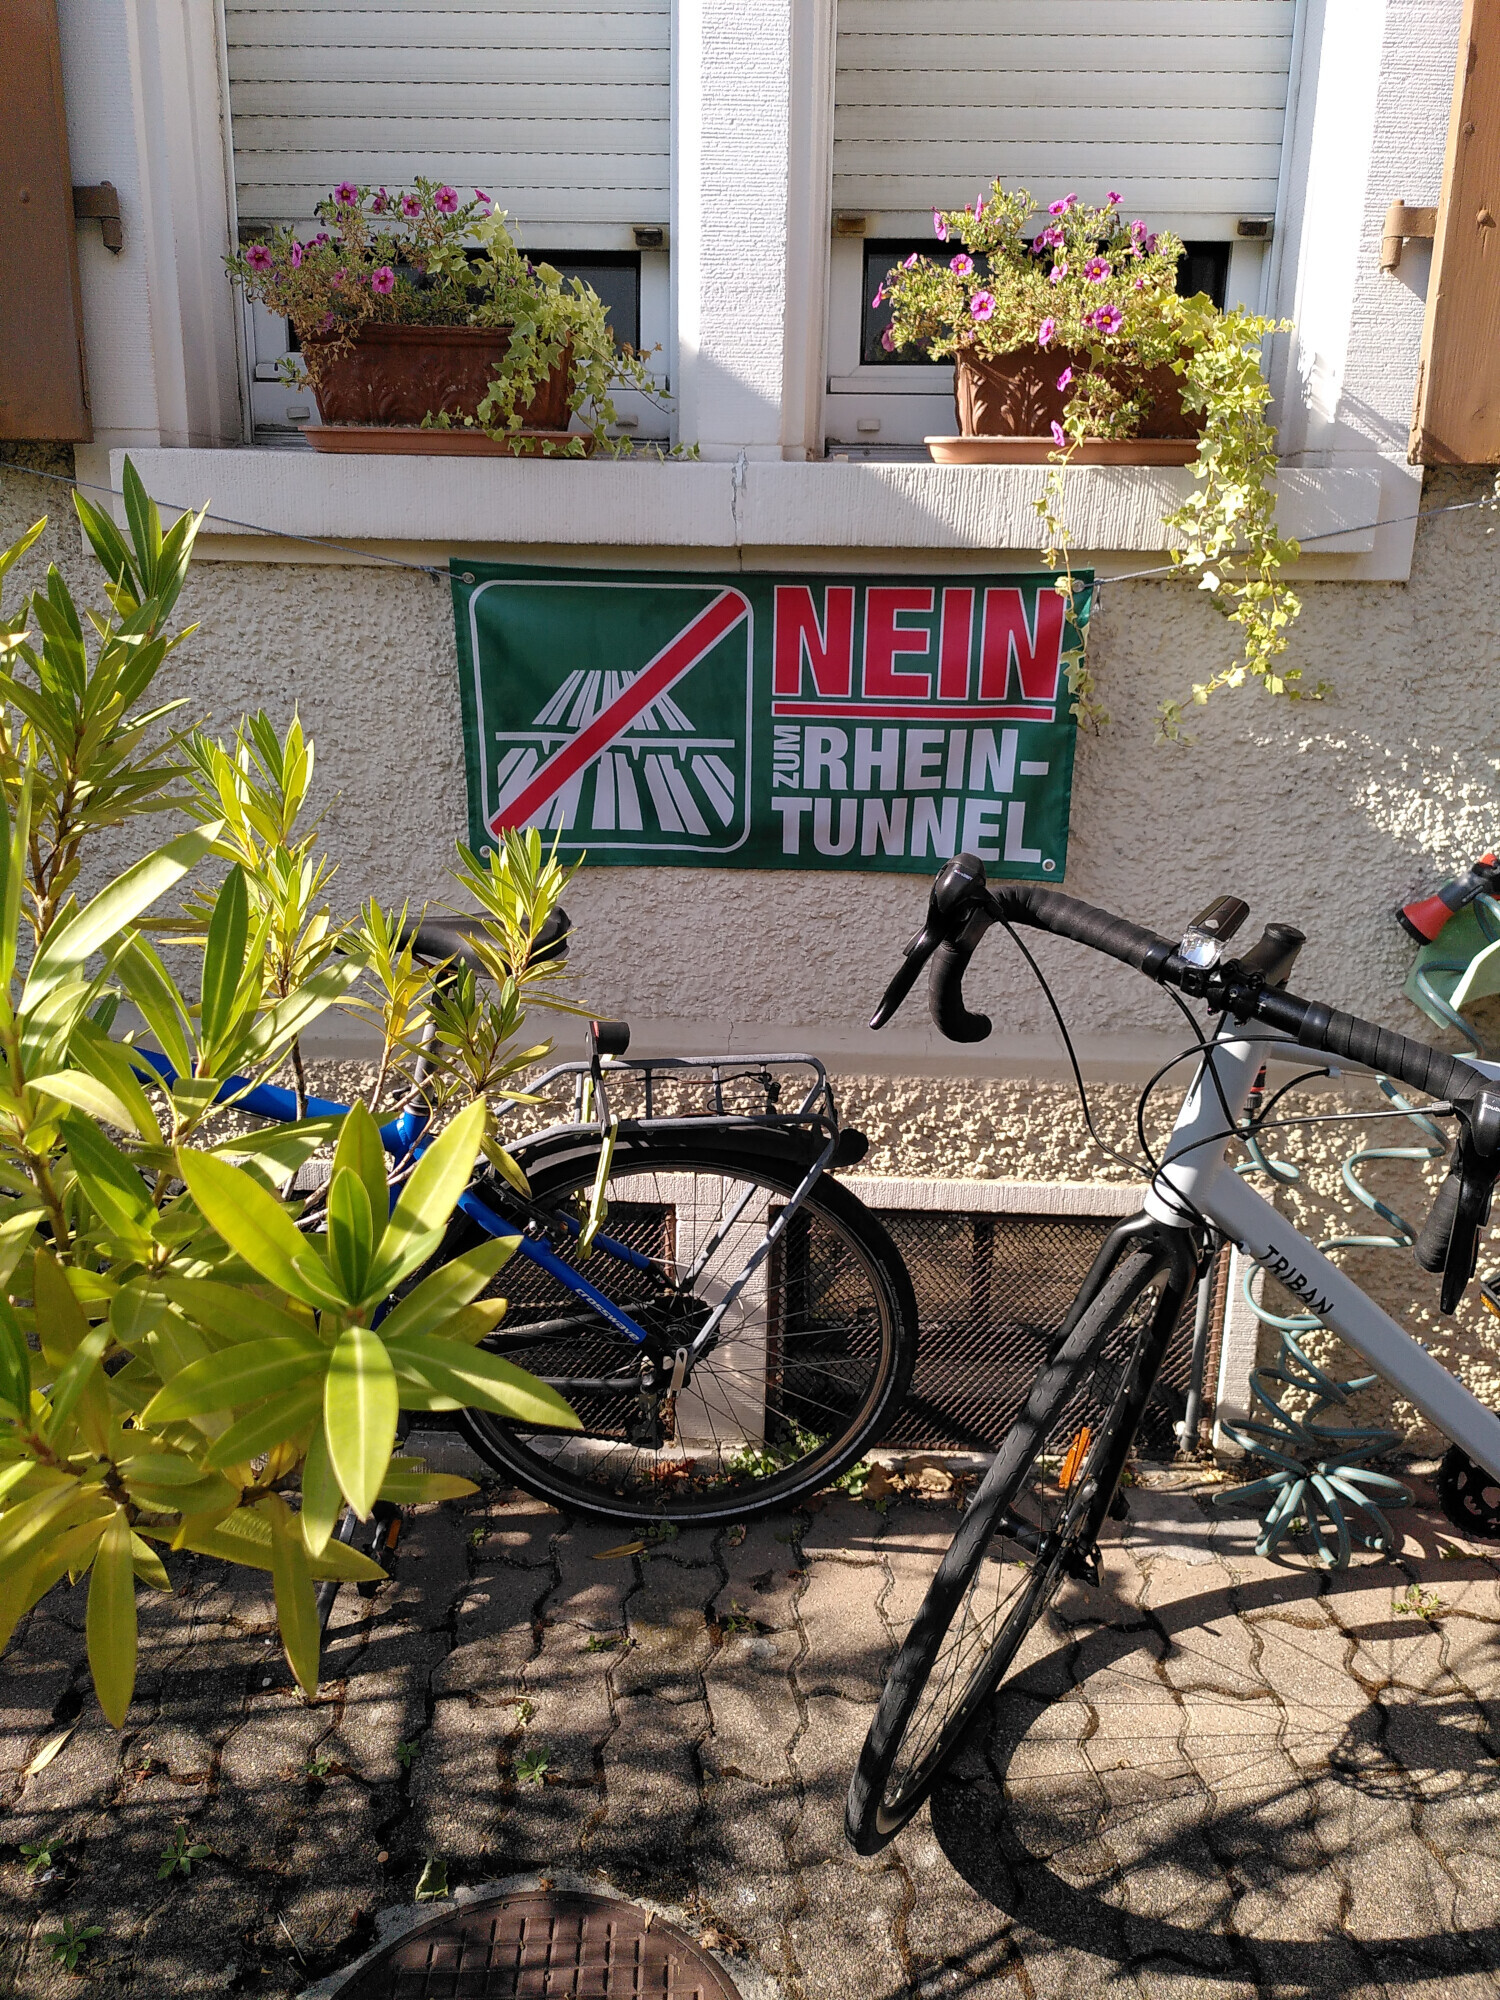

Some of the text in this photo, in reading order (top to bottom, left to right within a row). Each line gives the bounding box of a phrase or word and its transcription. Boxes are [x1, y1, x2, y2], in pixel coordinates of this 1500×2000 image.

[772, 584, 1067, 701] NEIN
[773, 725, 801, 788] ZUM
[804, 726, 1049, 793] RHEIN-
[771, 797, 1041, 863] TUNNEL
[1258, 1244, 1334, 1314] TRIBAN
[575, 1288, 640, 1341] crosswave
